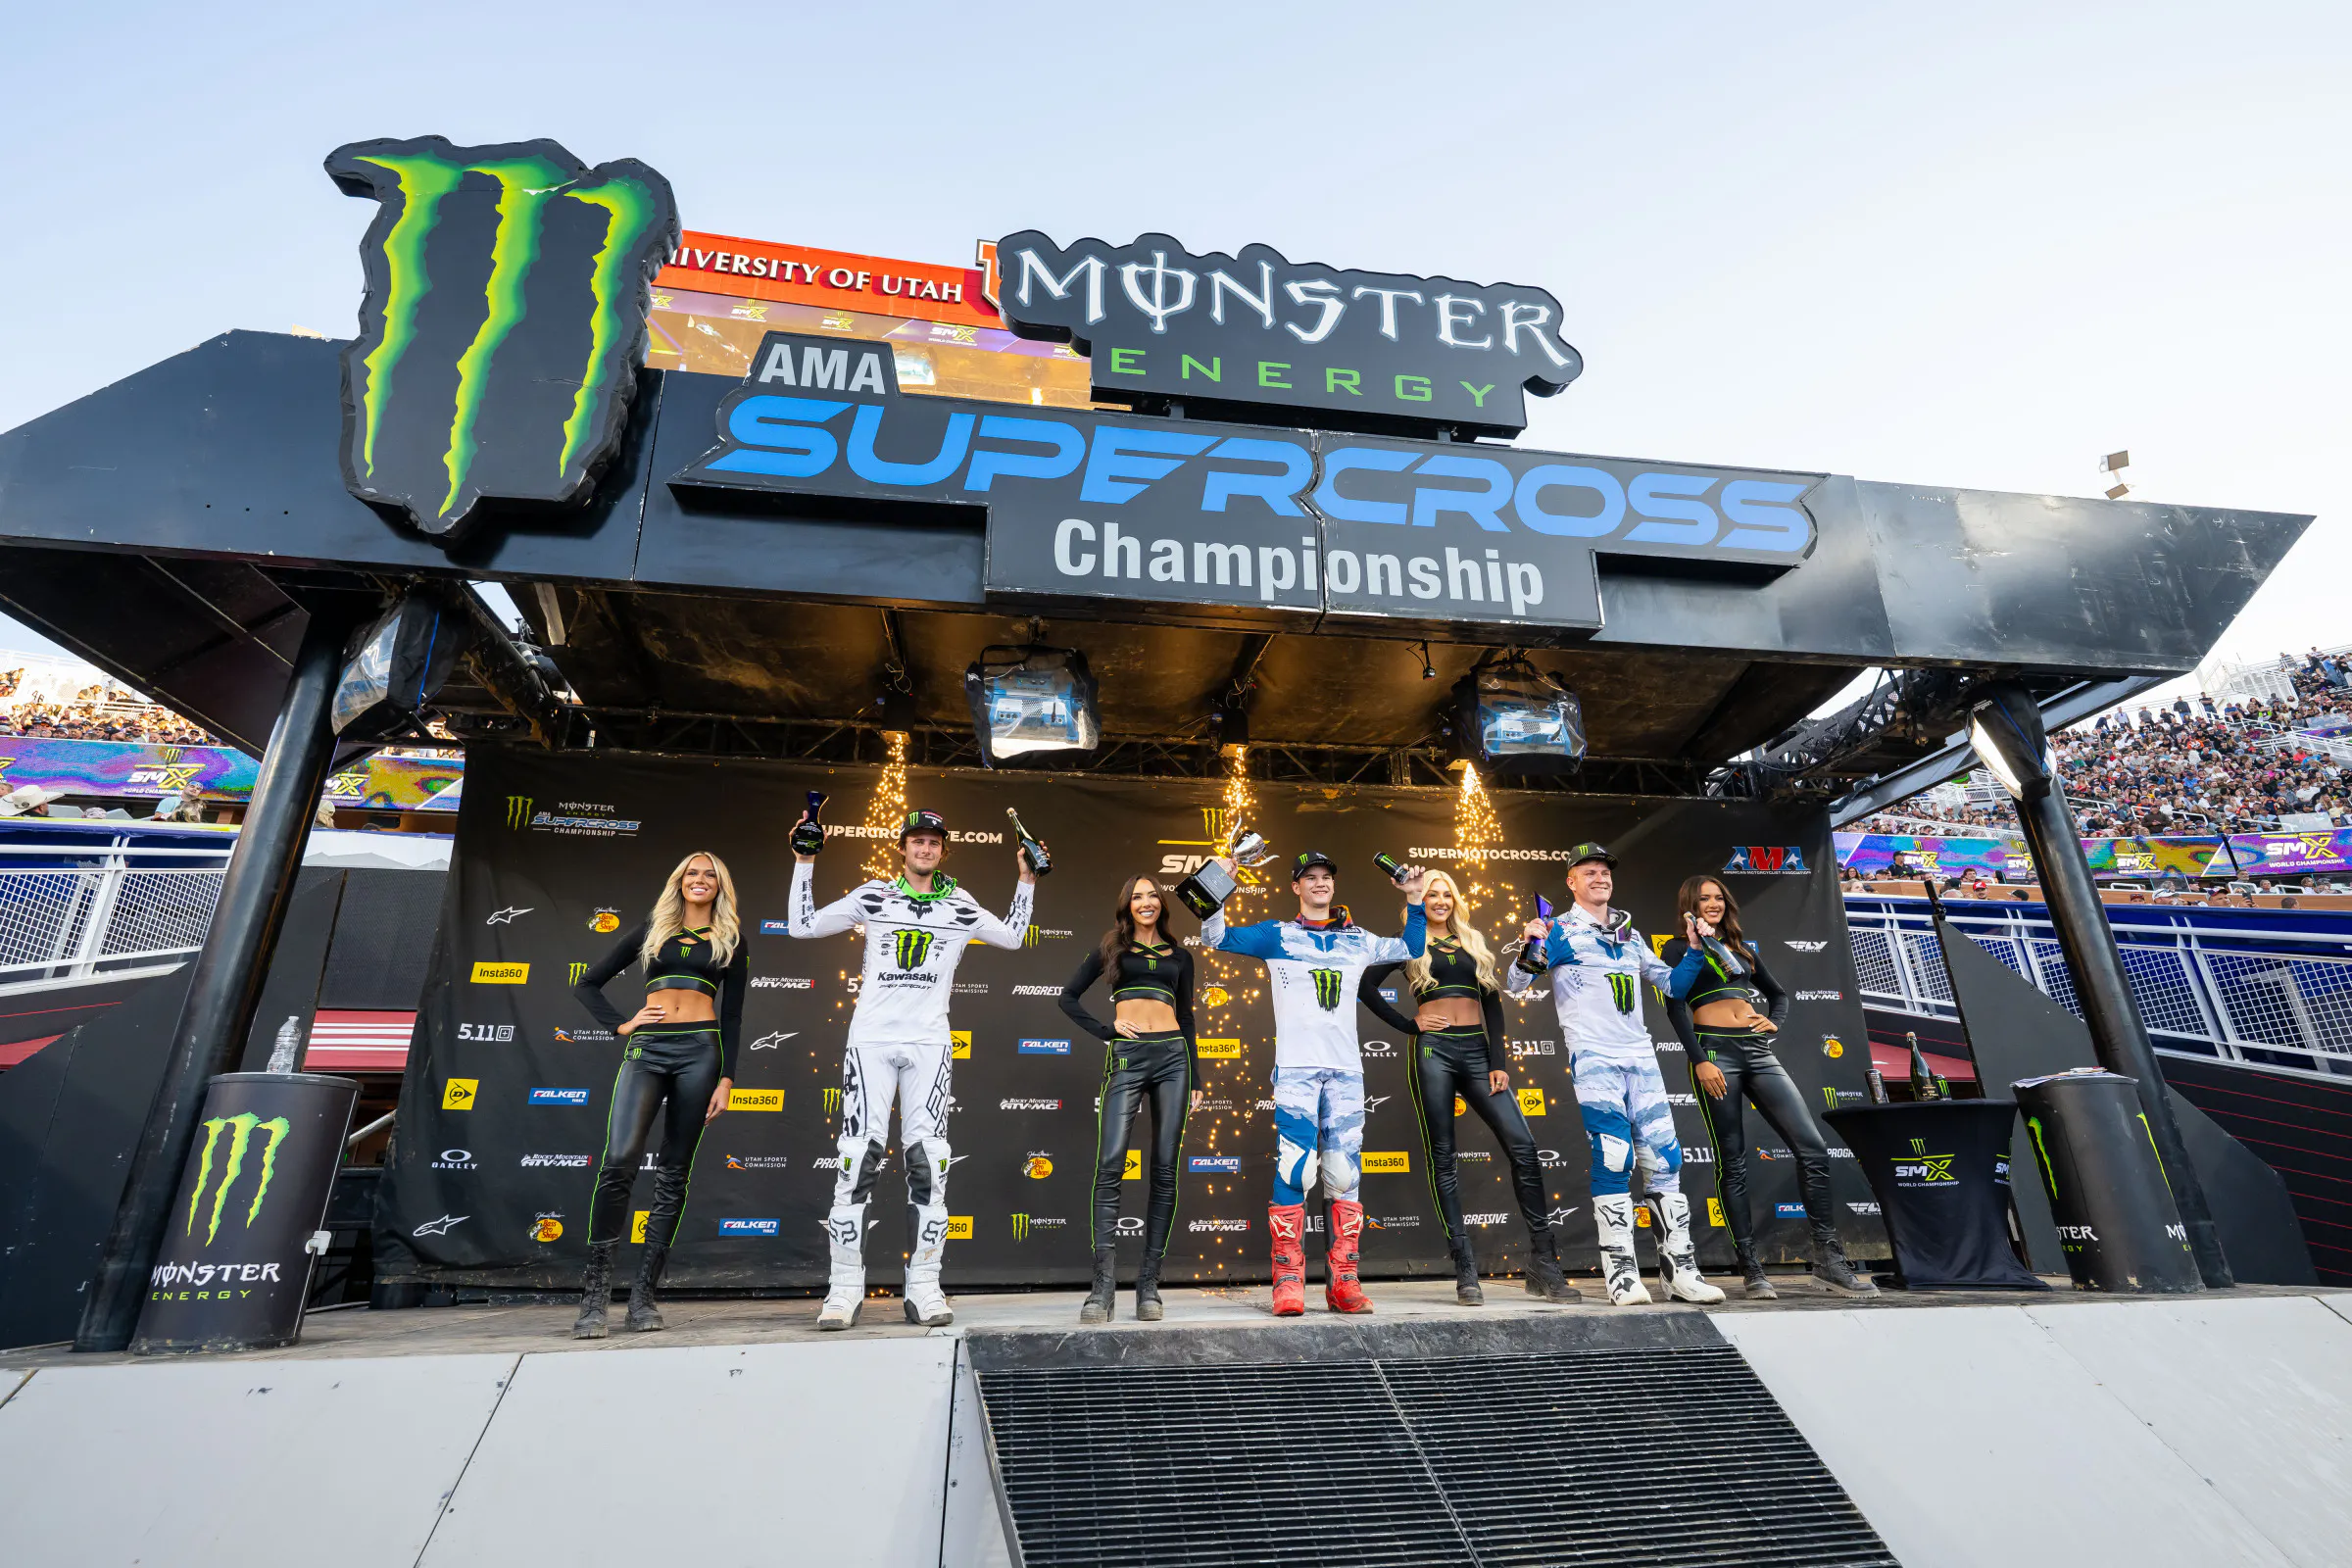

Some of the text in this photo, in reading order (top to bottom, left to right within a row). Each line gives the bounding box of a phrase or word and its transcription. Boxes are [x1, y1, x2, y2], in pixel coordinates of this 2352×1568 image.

[829, 268, 871, 291] OF
[881, 275, 962, 304] UTAH
[1014, 248, 1574, 369] MONSTER
[930, 325, 979, 343] SMX
[759, 343, 886, 395] AMA
[1110, 346, 1496, 408] ENERGY
[705, 394, 1830, 554] SUPERCROSS
[1053, 517, 1545, 616] Championship
[127, 767, 200, 789] SMX
[324, 776, 364, 796] MX
[559, 802, 615, 811] MONSTER
[530, 815, 642, 830] SUPERCROSS
[555, 827, 616, 836] CHAMPIONSHIP
[2265, 837, 2339, 859] SMX
[1722, 846, 1811, 870] AMA
[2116, 855, 2156, 870] SMX
[479, 968, 522, 978] Insta360
[877, 971, 938, 983] Kawasaki
[457, 1023, 494, 1041] 5.11
[1512, 1040, 1541, 1055] 5.11
[732, 1096, 778, 1105] Insta360
[431, 1161, 478, 1170] OAKLEY
[1364, 1157, 1404, 1167] Insta360
[1895, 1159, 1956, 1181] SMX
[1995, 1162, 2009, 1174] SM
[150, 1261, 281, 1288] MONSTER
[152, 1289, 252, 1300] ENERGY
